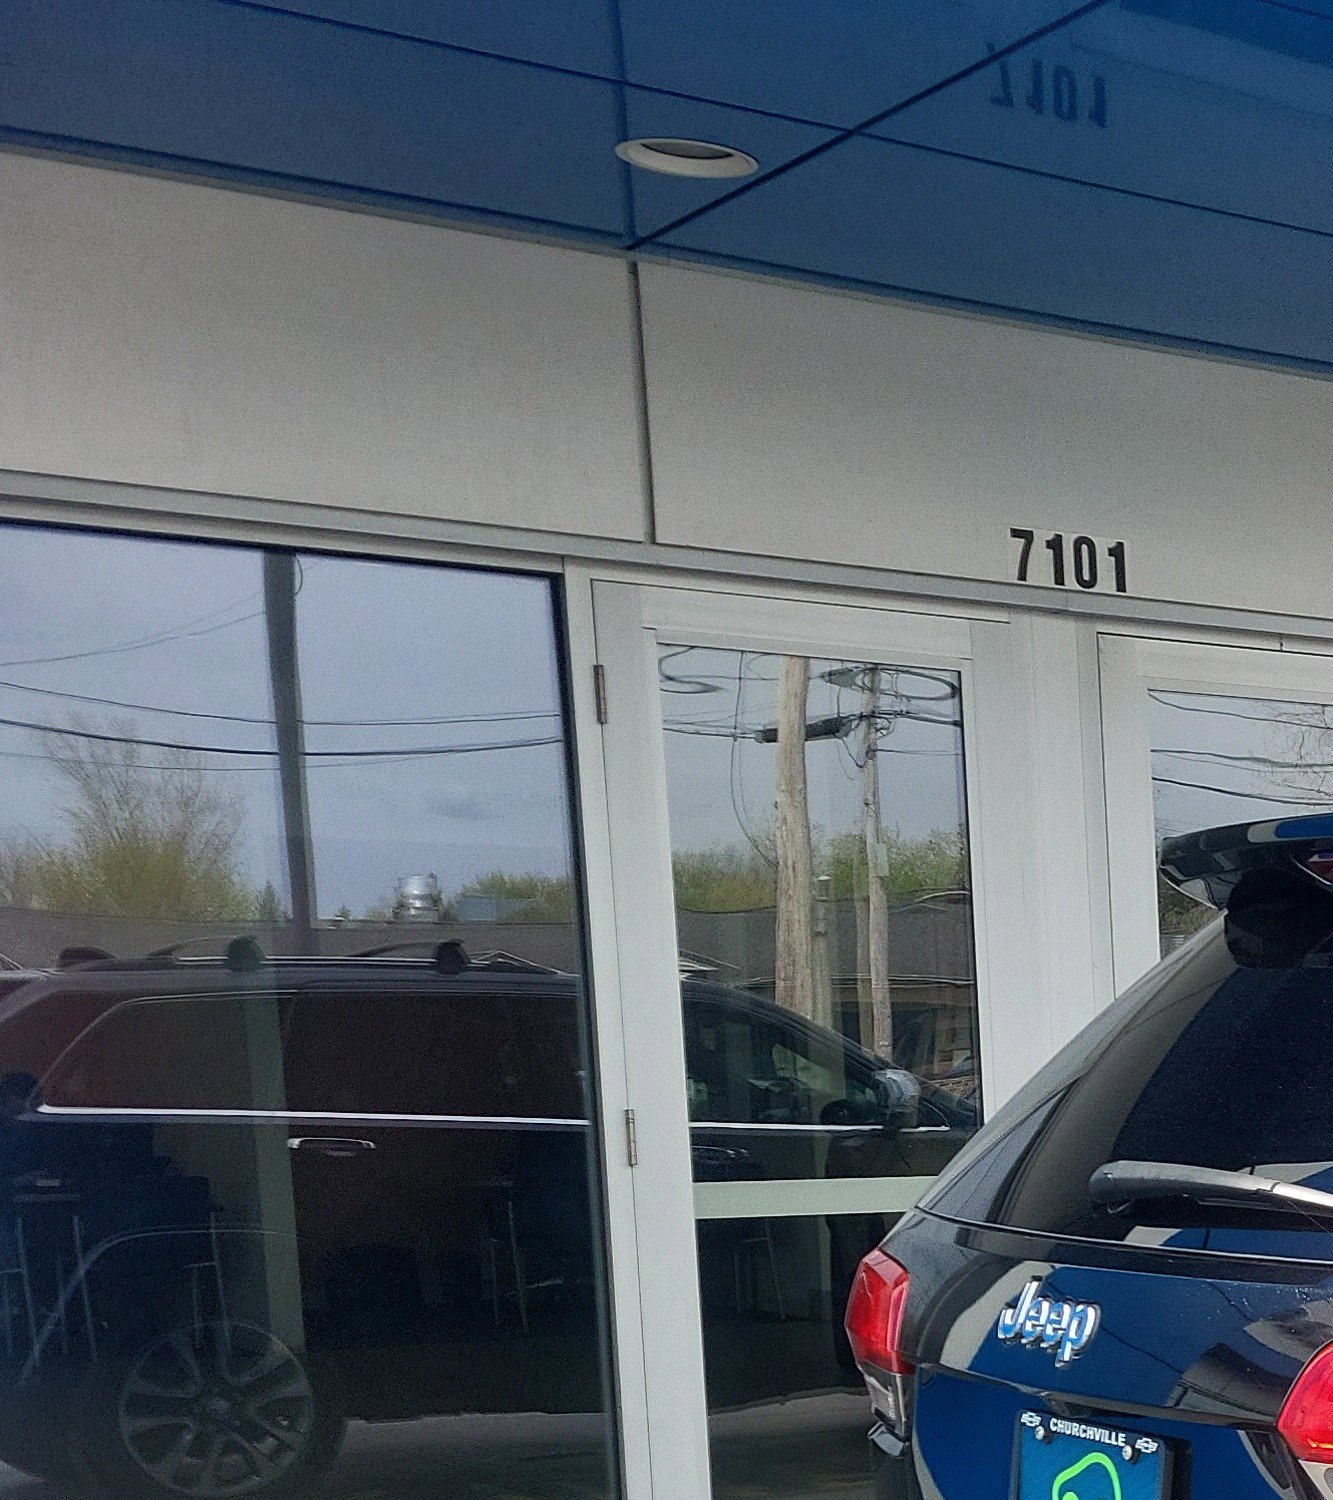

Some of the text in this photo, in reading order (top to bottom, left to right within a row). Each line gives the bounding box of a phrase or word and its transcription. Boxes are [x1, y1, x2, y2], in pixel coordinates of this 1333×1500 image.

[1009, 527, 1127, 593] 7101
[998, 1278, 1099, 1365] Jeep
[1050, 1418, 1126, 1447] CHURCHVILLE
